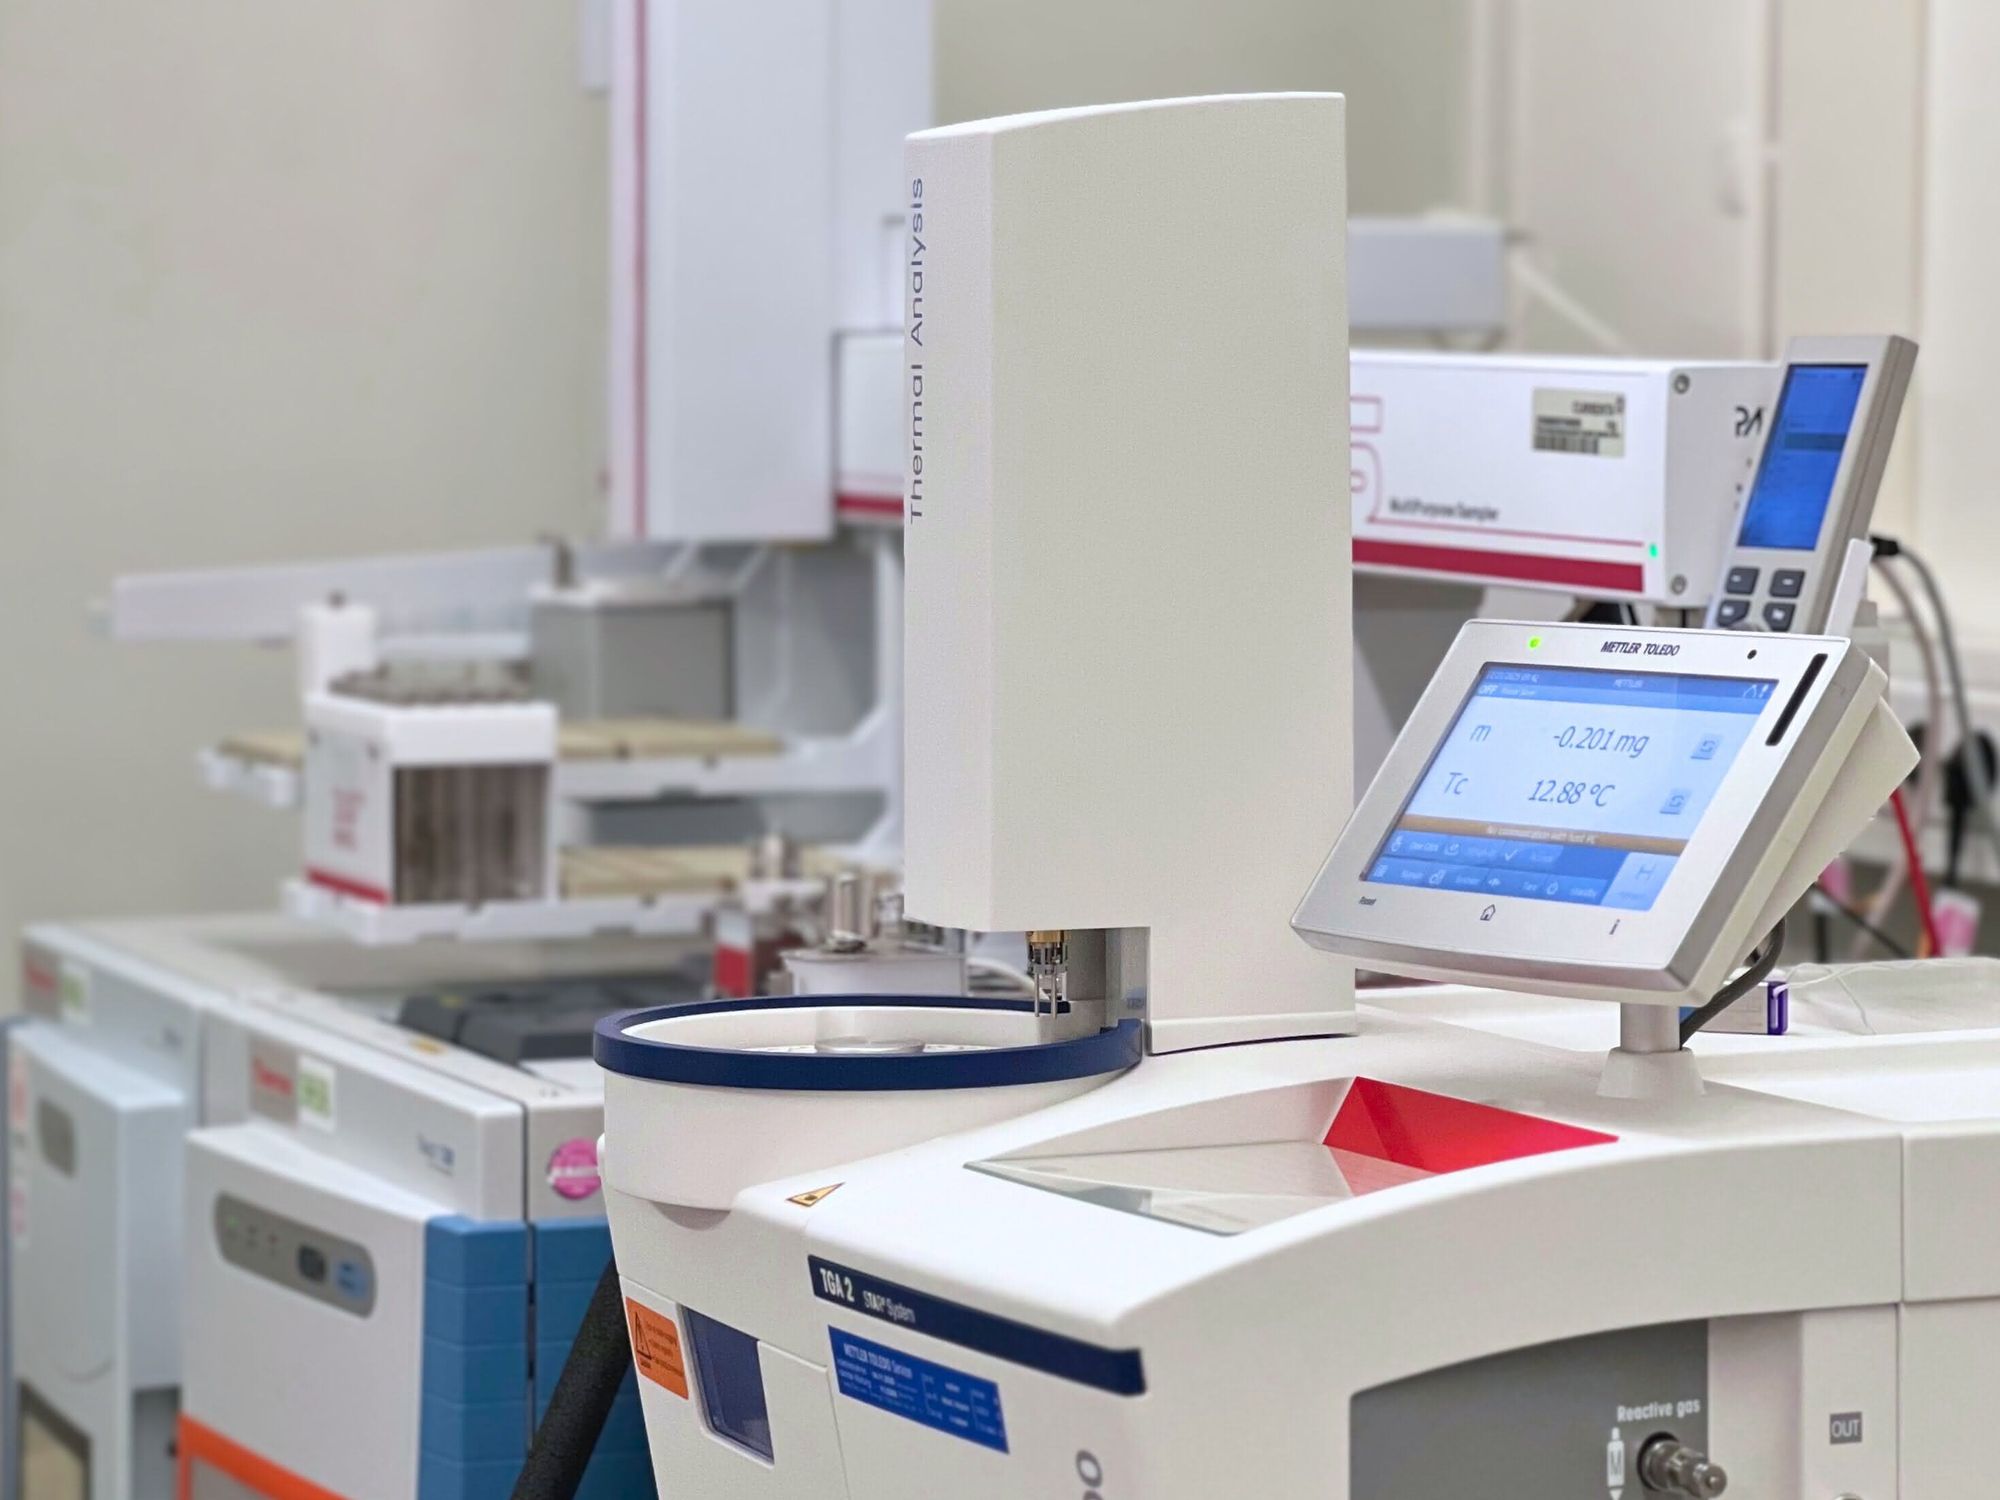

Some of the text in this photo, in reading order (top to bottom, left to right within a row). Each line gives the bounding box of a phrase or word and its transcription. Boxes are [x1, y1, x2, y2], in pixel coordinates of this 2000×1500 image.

[910, 178, 927, 524] Thermal Analysis
[1600, 641, 1681, 657] METTLER TOLEDO
[1470, 725, 1492, 742] m
[1553, 725, 1650, 759] -0.201 mg
[1443, 771, 1468, 796] Tc
[1528, 779, 1587, 806] 12.88
[819, 1267, 845, 1300] TGA
[844, 1276, 855, 1303] 2
[1617, 1399, 1701, 1423] Reactive gas
[1831, 1419, 1861, 1439] OUT
